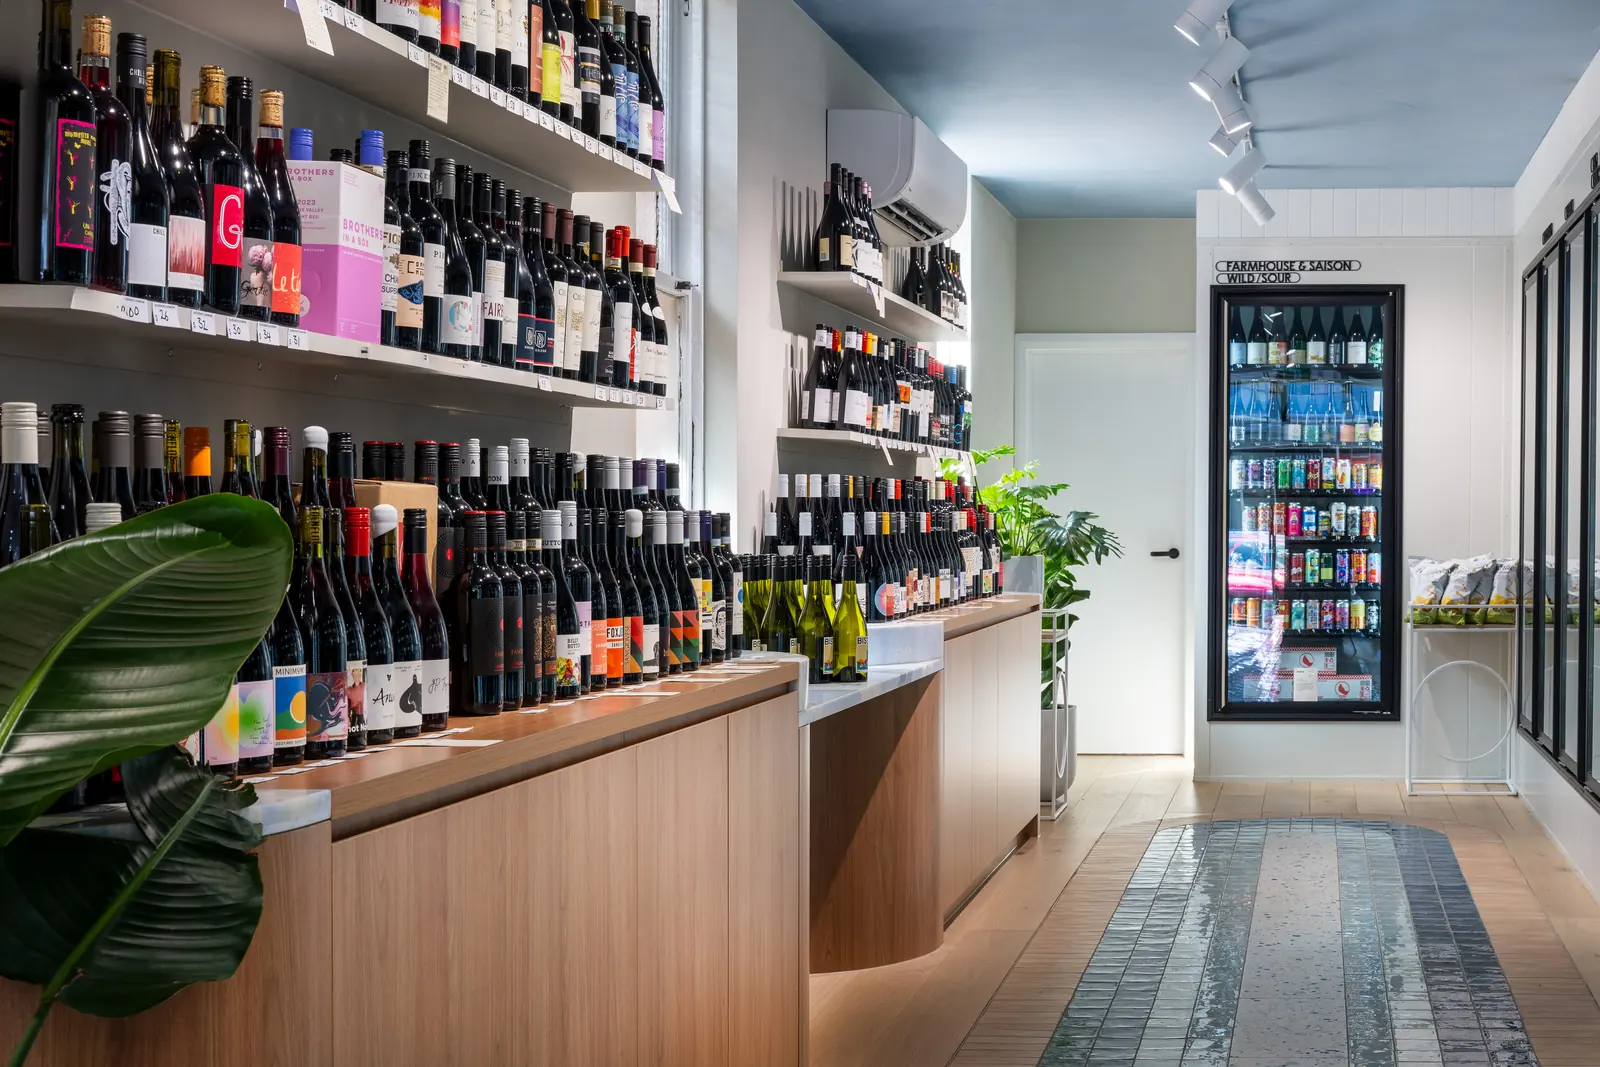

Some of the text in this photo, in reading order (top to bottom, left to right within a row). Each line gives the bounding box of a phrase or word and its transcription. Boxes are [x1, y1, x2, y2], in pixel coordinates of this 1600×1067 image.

[288, 168, 335, 176] ROTHERS
[343, 218, 384, 241] BROTHERS
[1226, 260, 1352, 272] FARMHOUSE & SAISON
